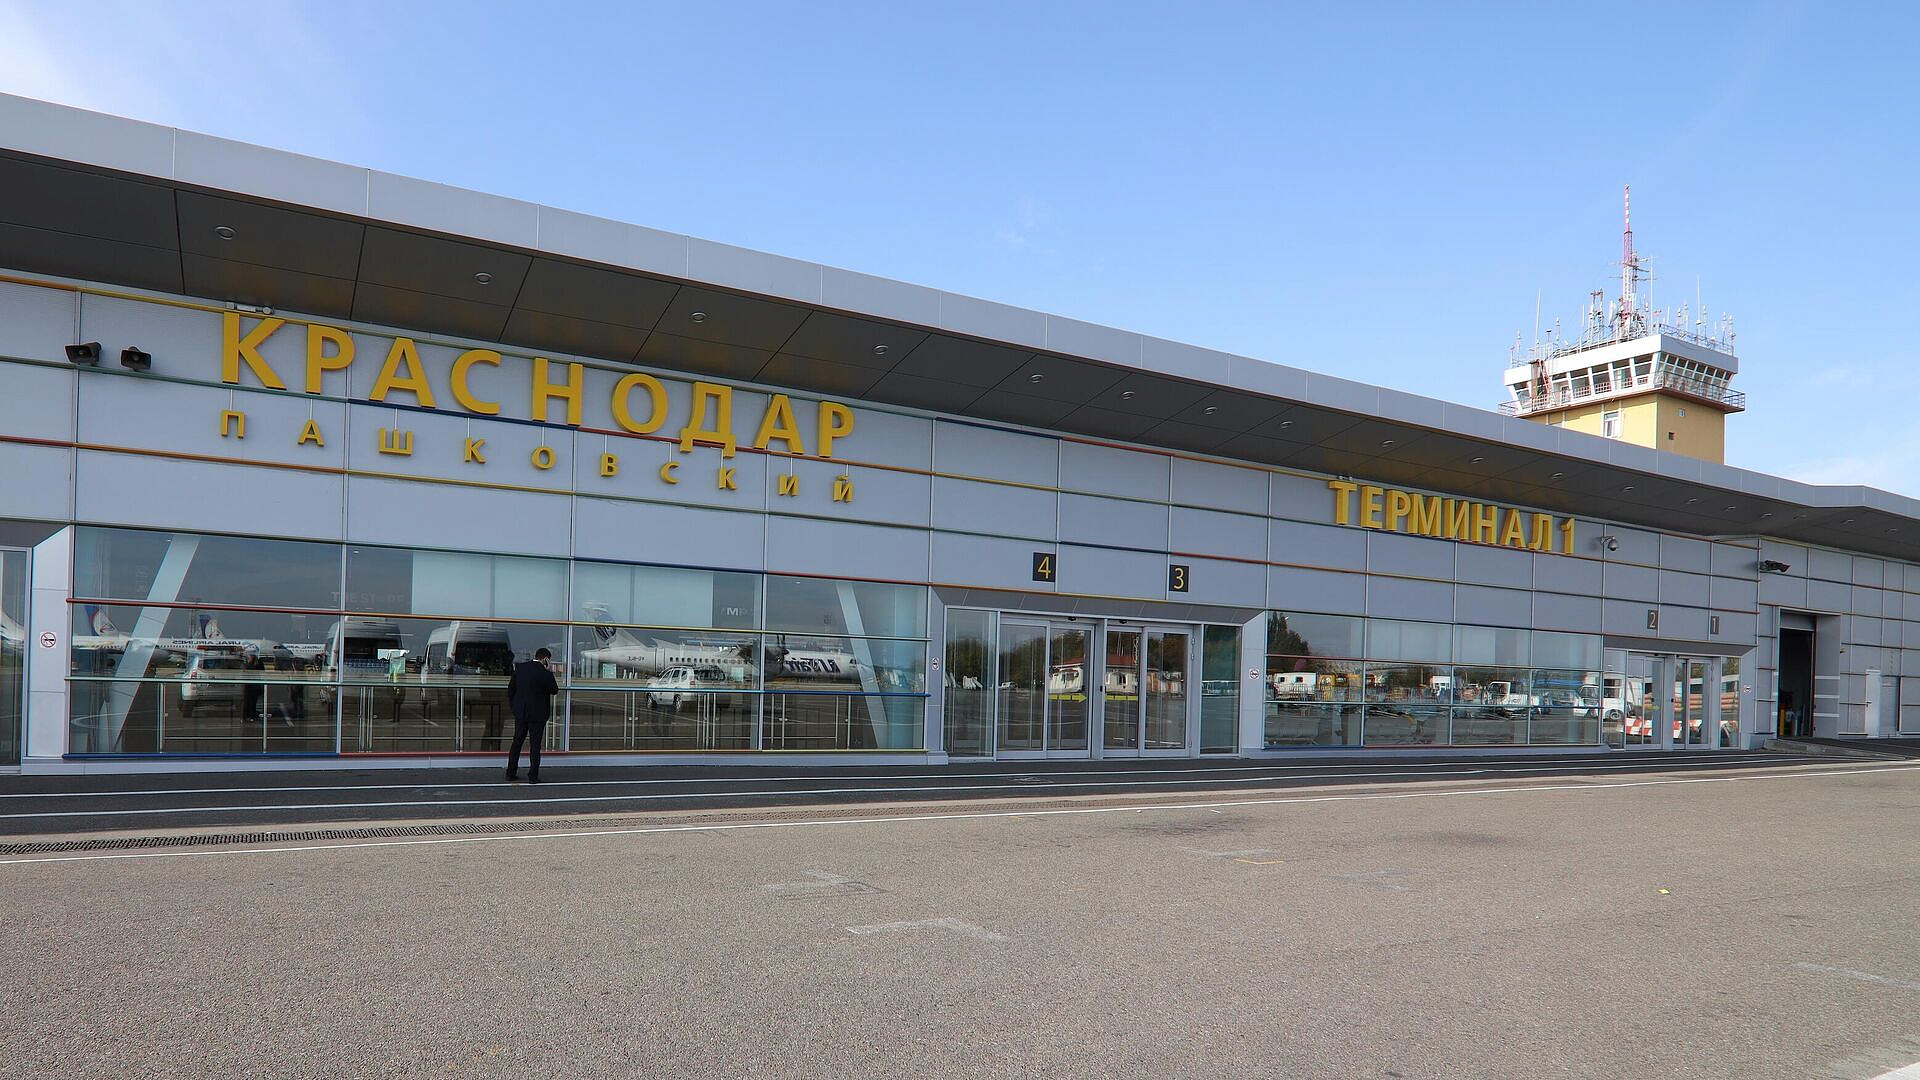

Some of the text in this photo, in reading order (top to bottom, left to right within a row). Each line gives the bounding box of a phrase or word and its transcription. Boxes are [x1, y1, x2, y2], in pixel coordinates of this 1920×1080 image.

[222, 311, 856, 458] КРАСНОДАР
[221, 410, 854, 503] ПАШКОВСКИЙ
[1328, 480, 1576, 555] ТЕРМИНАЛ 1
[1037, 556, 1051, 579] 4
[1173, 567, 1185, 590] 3
[1649, 611, 1656, 628] 2
